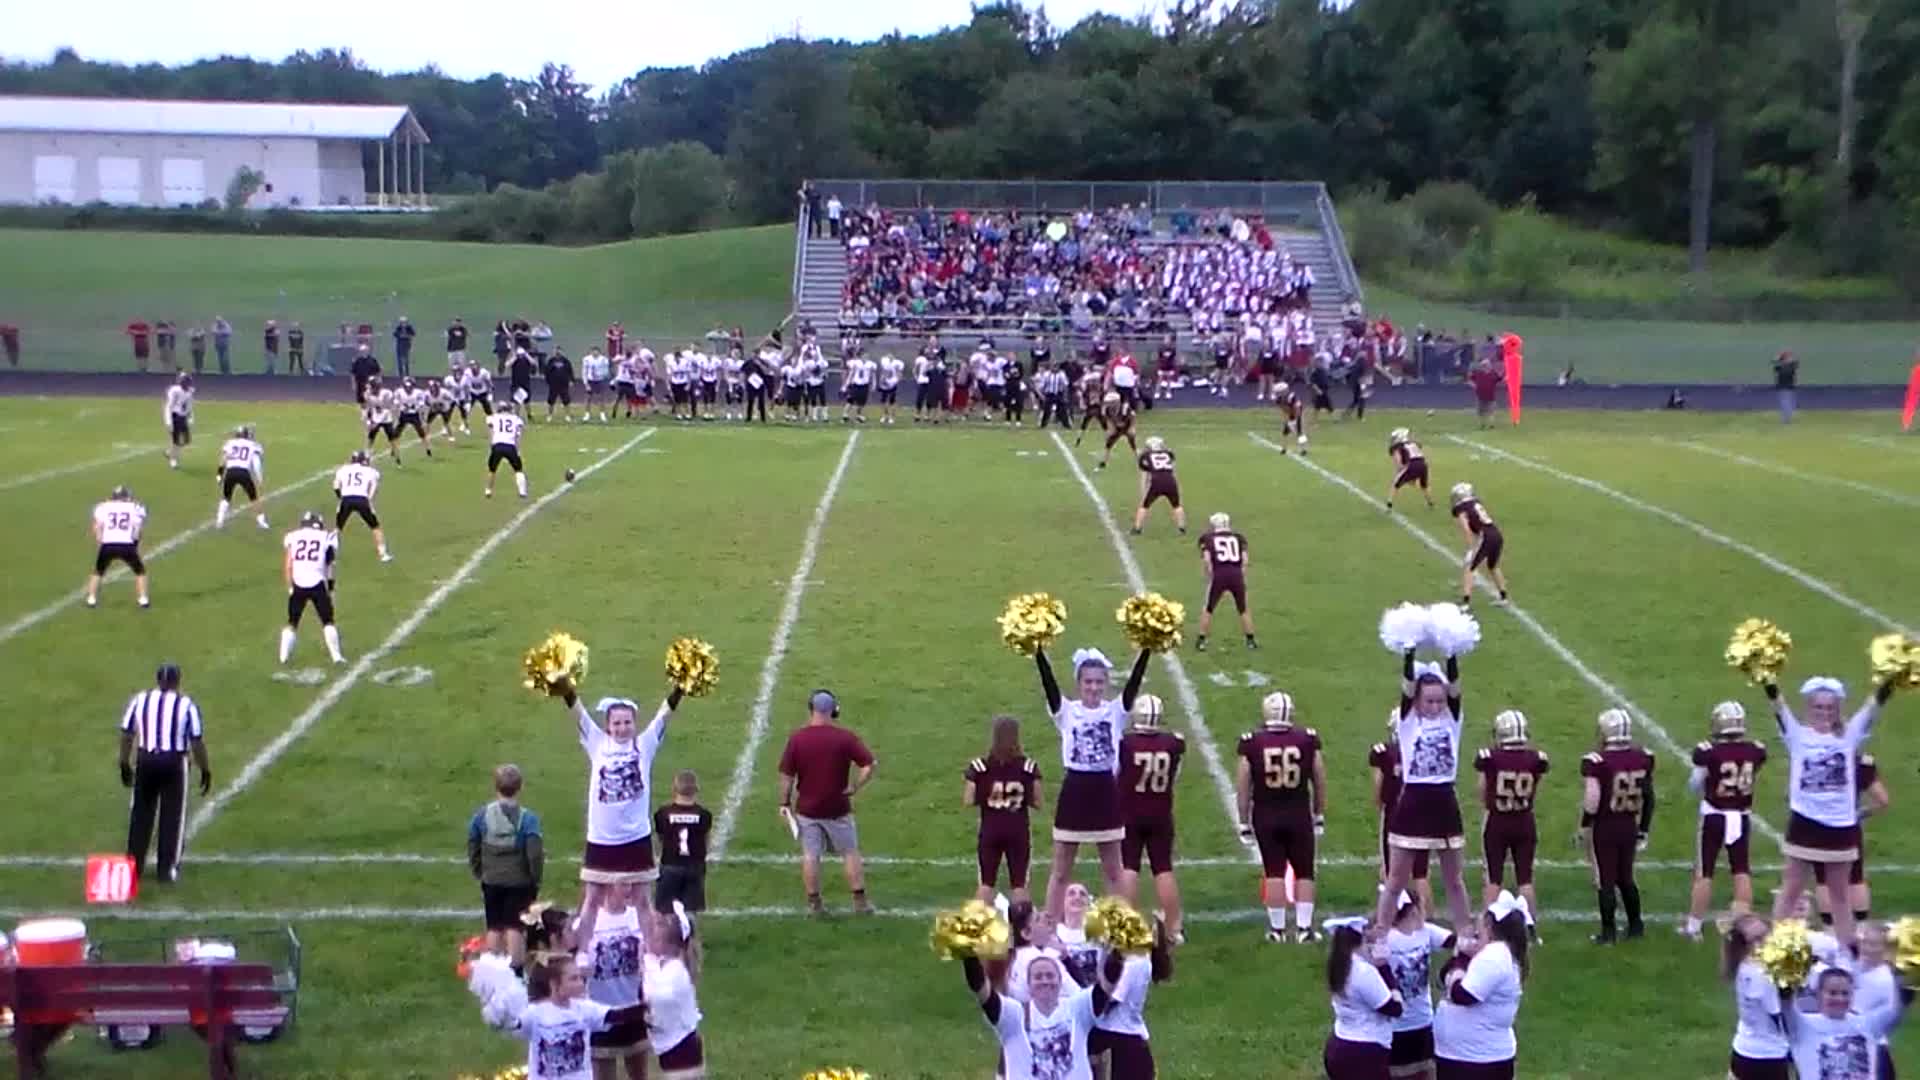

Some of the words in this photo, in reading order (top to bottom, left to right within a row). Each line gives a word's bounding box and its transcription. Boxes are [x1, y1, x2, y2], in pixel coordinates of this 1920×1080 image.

[499, 418, 513, 433] 12
[1150, 452, 1173, 470] 62
[347, 471, 363, 487] 15
[107, 511, 131, 530] 32
[295, 539, 321, 561] 22
[1214, 535, 1240, 562] 50
[1133, 751, 1170, 793] 78
[1263, 745, 1301, 788] 56
[1610, 769, 1647, 813] 65
[679, 828, 689, 856] 1
[90, 860, 131, 902] 40
